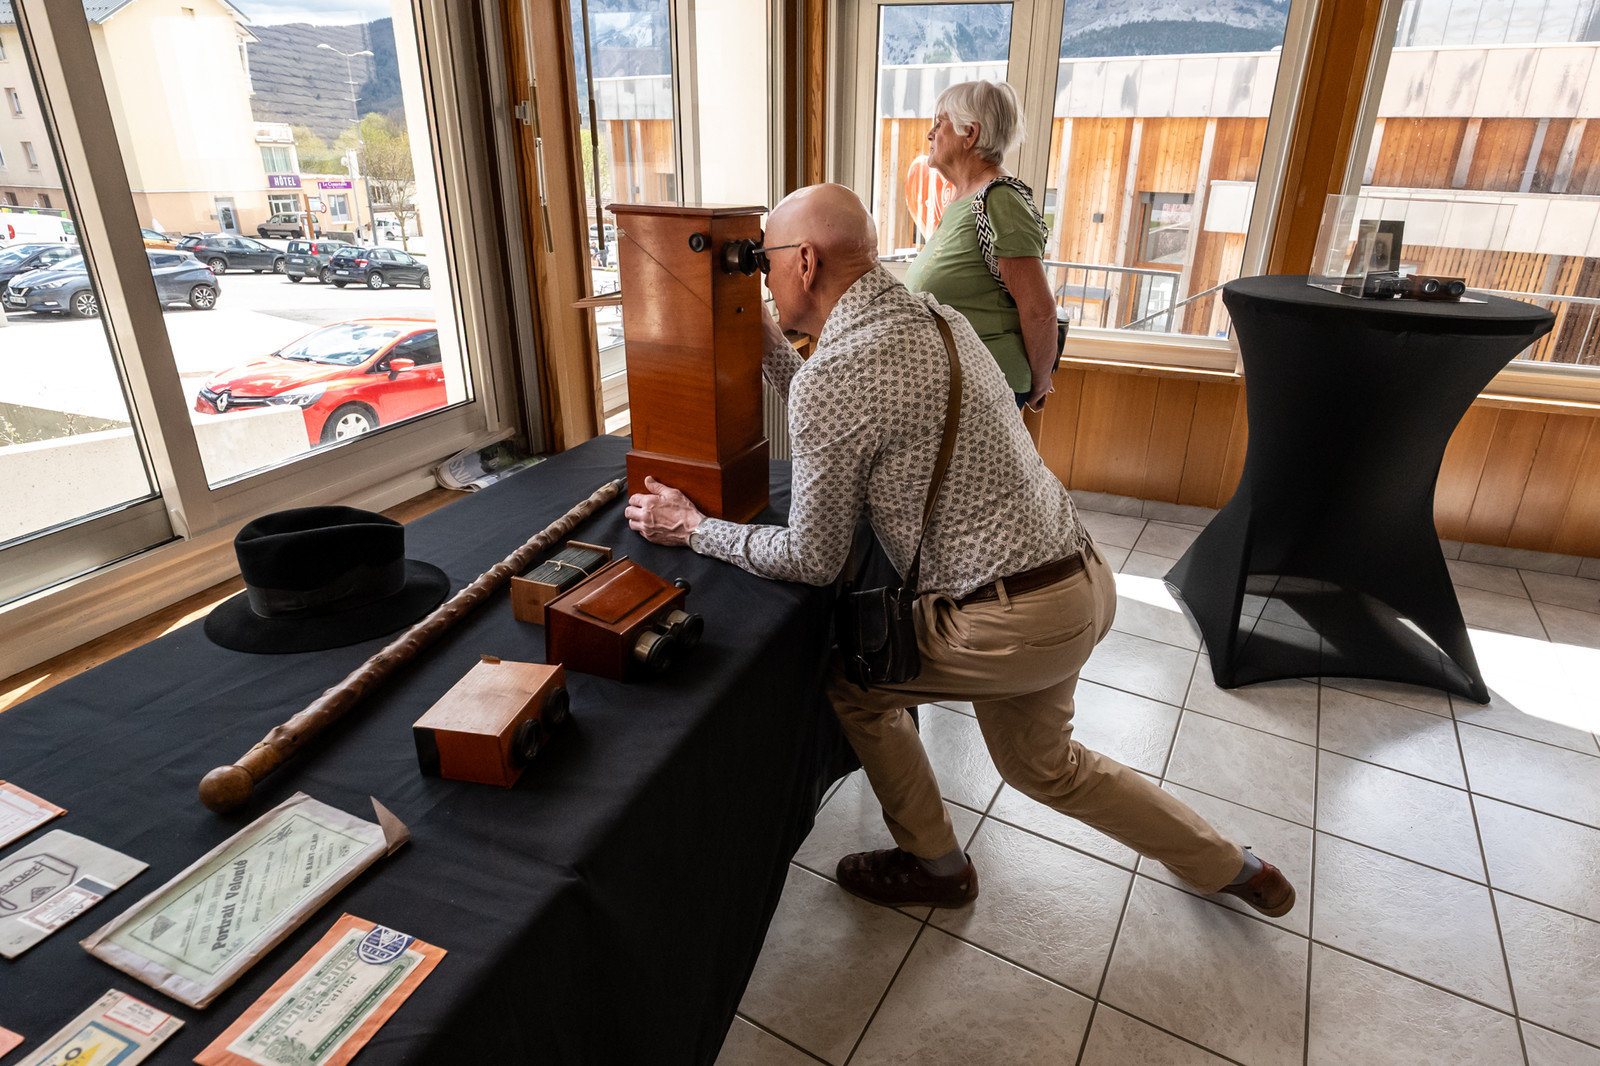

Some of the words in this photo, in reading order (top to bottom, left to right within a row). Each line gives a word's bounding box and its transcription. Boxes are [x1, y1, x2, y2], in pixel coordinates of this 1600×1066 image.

[274, 175, 297, 187] HÔTEL
[302, 872, 311, 888] Félix
[211, 903, 236, 951] Portrait
[224, 859, 248, 900] Velouté
[258, 989, 322, 1047] PAPIER
[319, 948, 359, 986] RIDA
[307, 975, 358, 1023] GEVAERT
